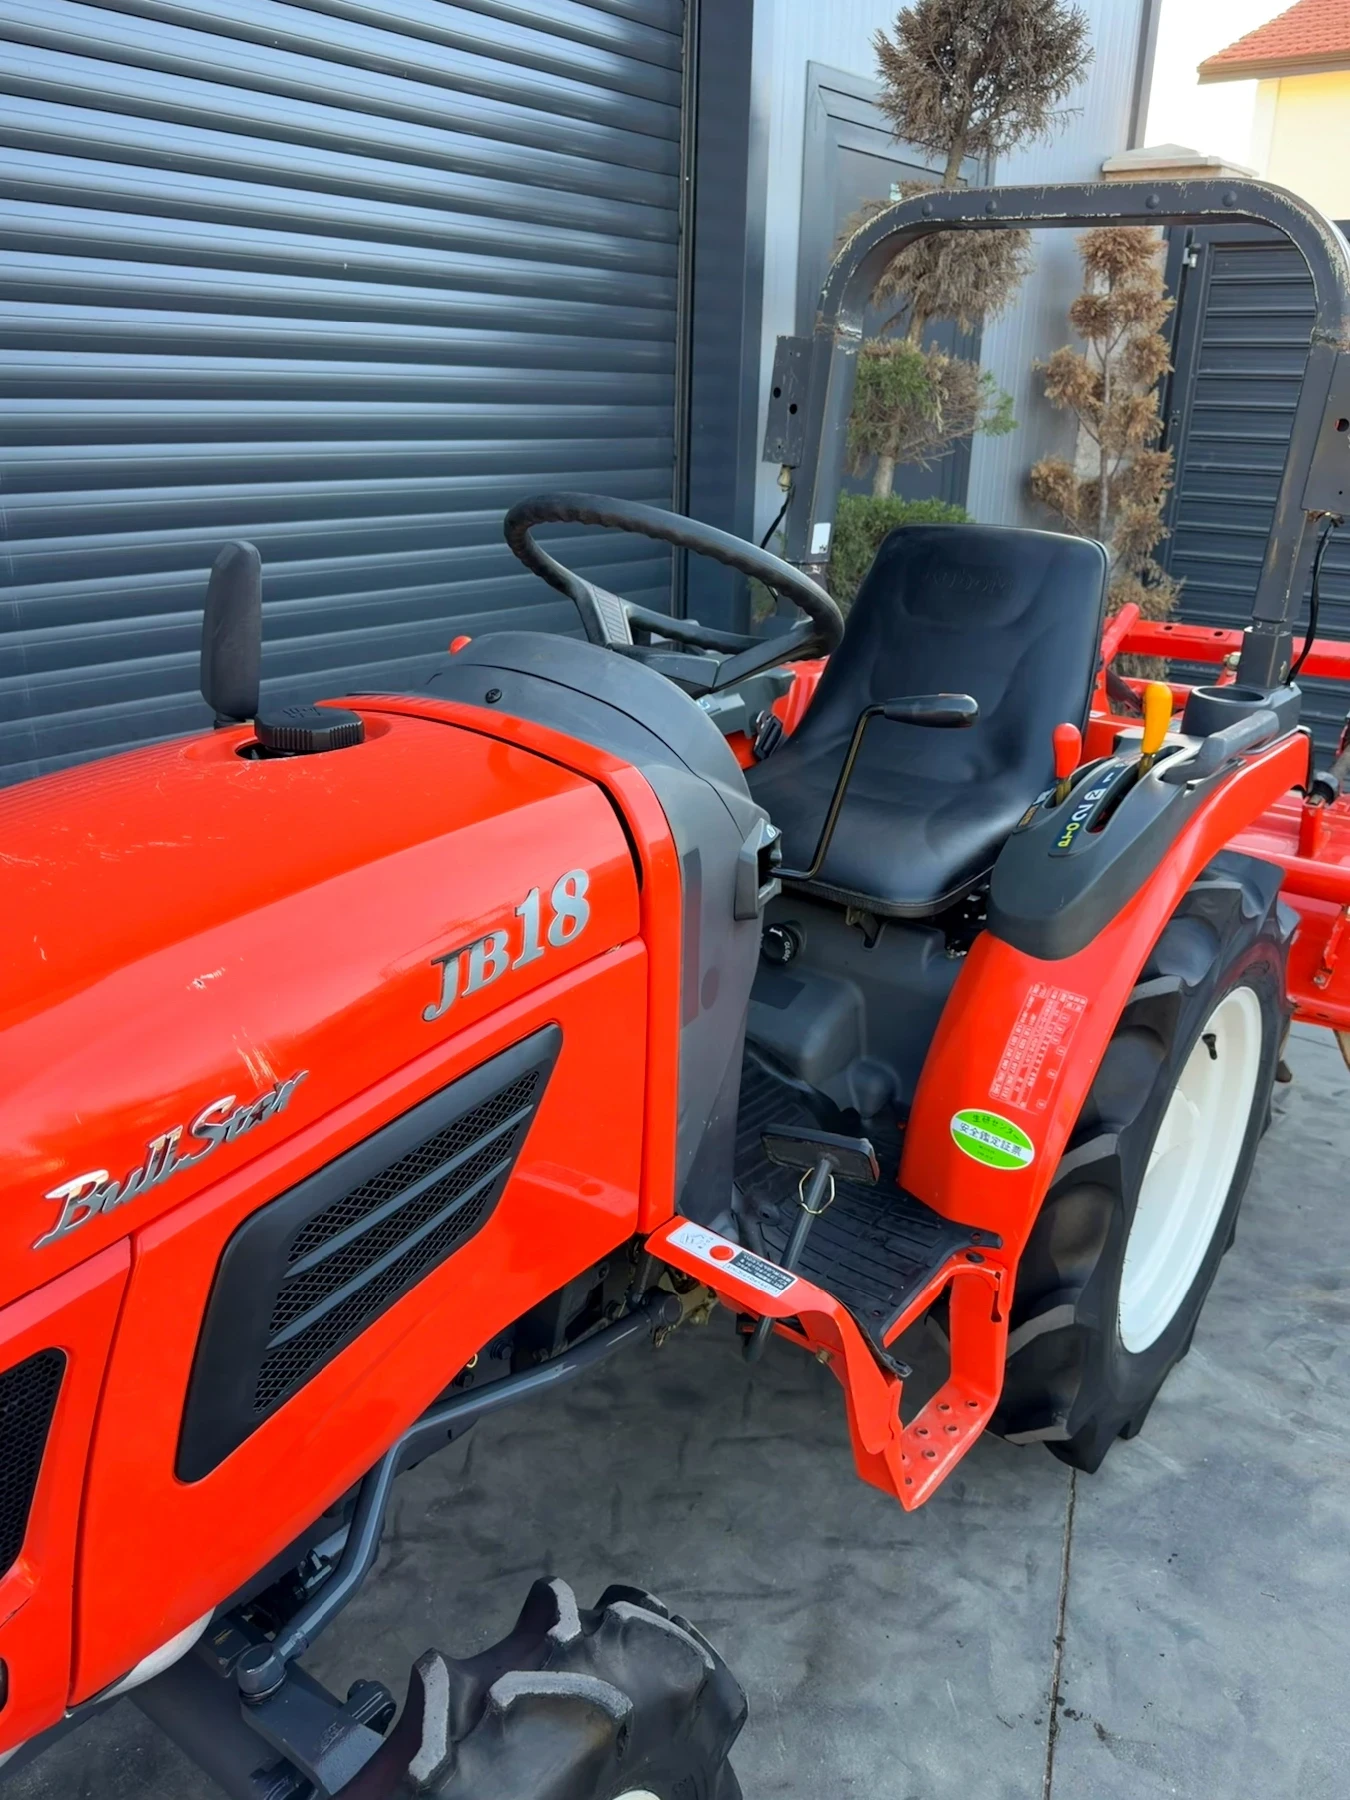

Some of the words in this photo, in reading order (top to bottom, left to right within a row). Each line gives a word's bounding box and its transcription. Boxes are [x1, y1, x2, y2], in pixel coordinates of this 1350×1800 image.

[1057, 822, 1081, 848] PTO
[422, 868, 591, 1023] JB18
[31, 1124, 184, 1250] Bull
[176, 1069, 310, 1167] Star
